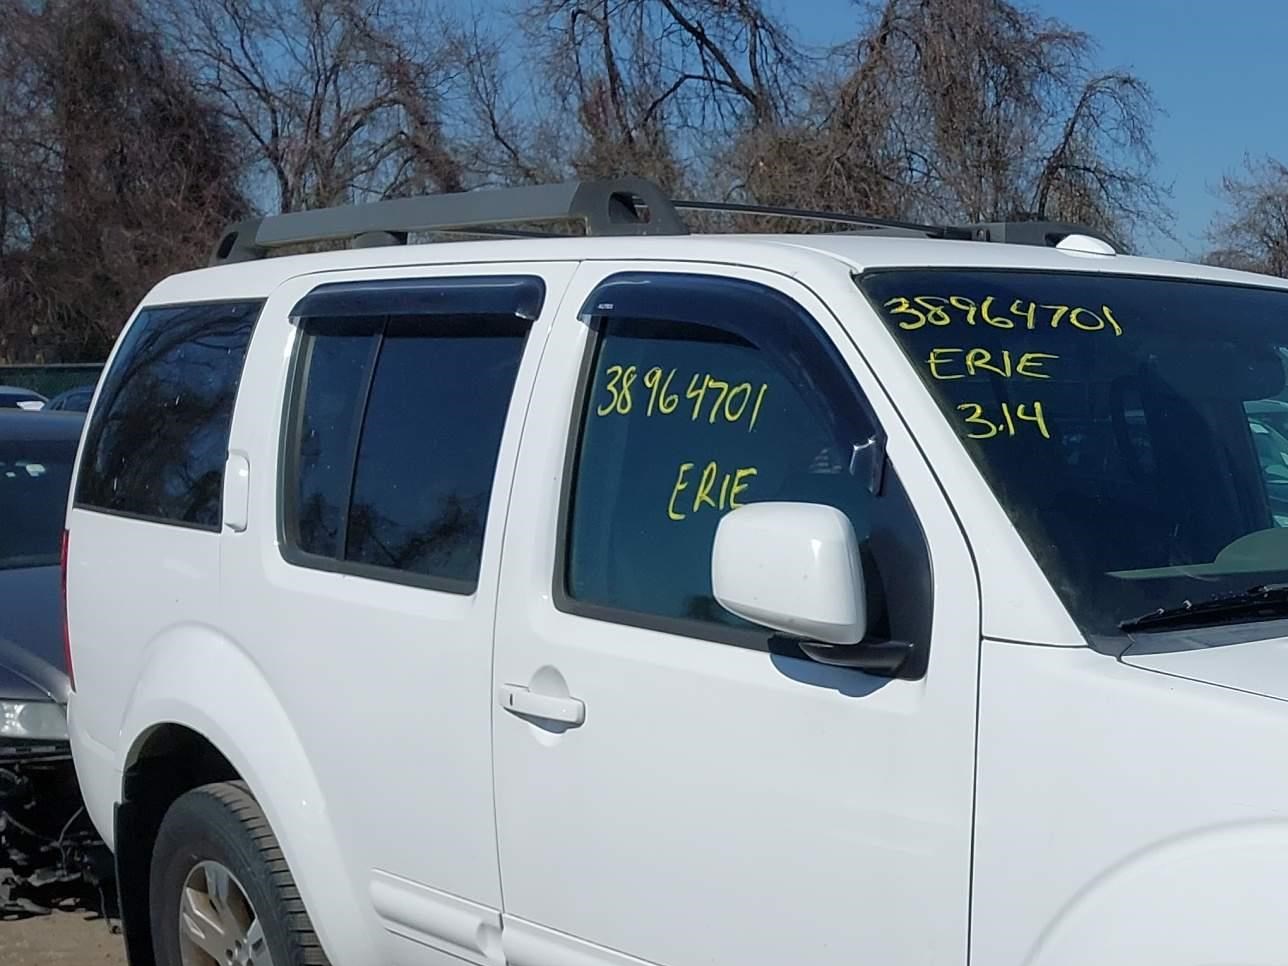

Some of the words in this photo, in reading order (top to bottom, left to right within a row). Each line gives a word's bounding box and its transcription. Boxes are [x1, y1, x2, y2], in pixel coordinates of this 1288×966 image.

[884, 296, 1122, 336] 38964701
[925, 348, 1060, 379] ERIE
[597, 365, 768, 433] 38964701
[957, 402, 1050, 439] 3.14
[668, 461, 758, 520] ERIE
